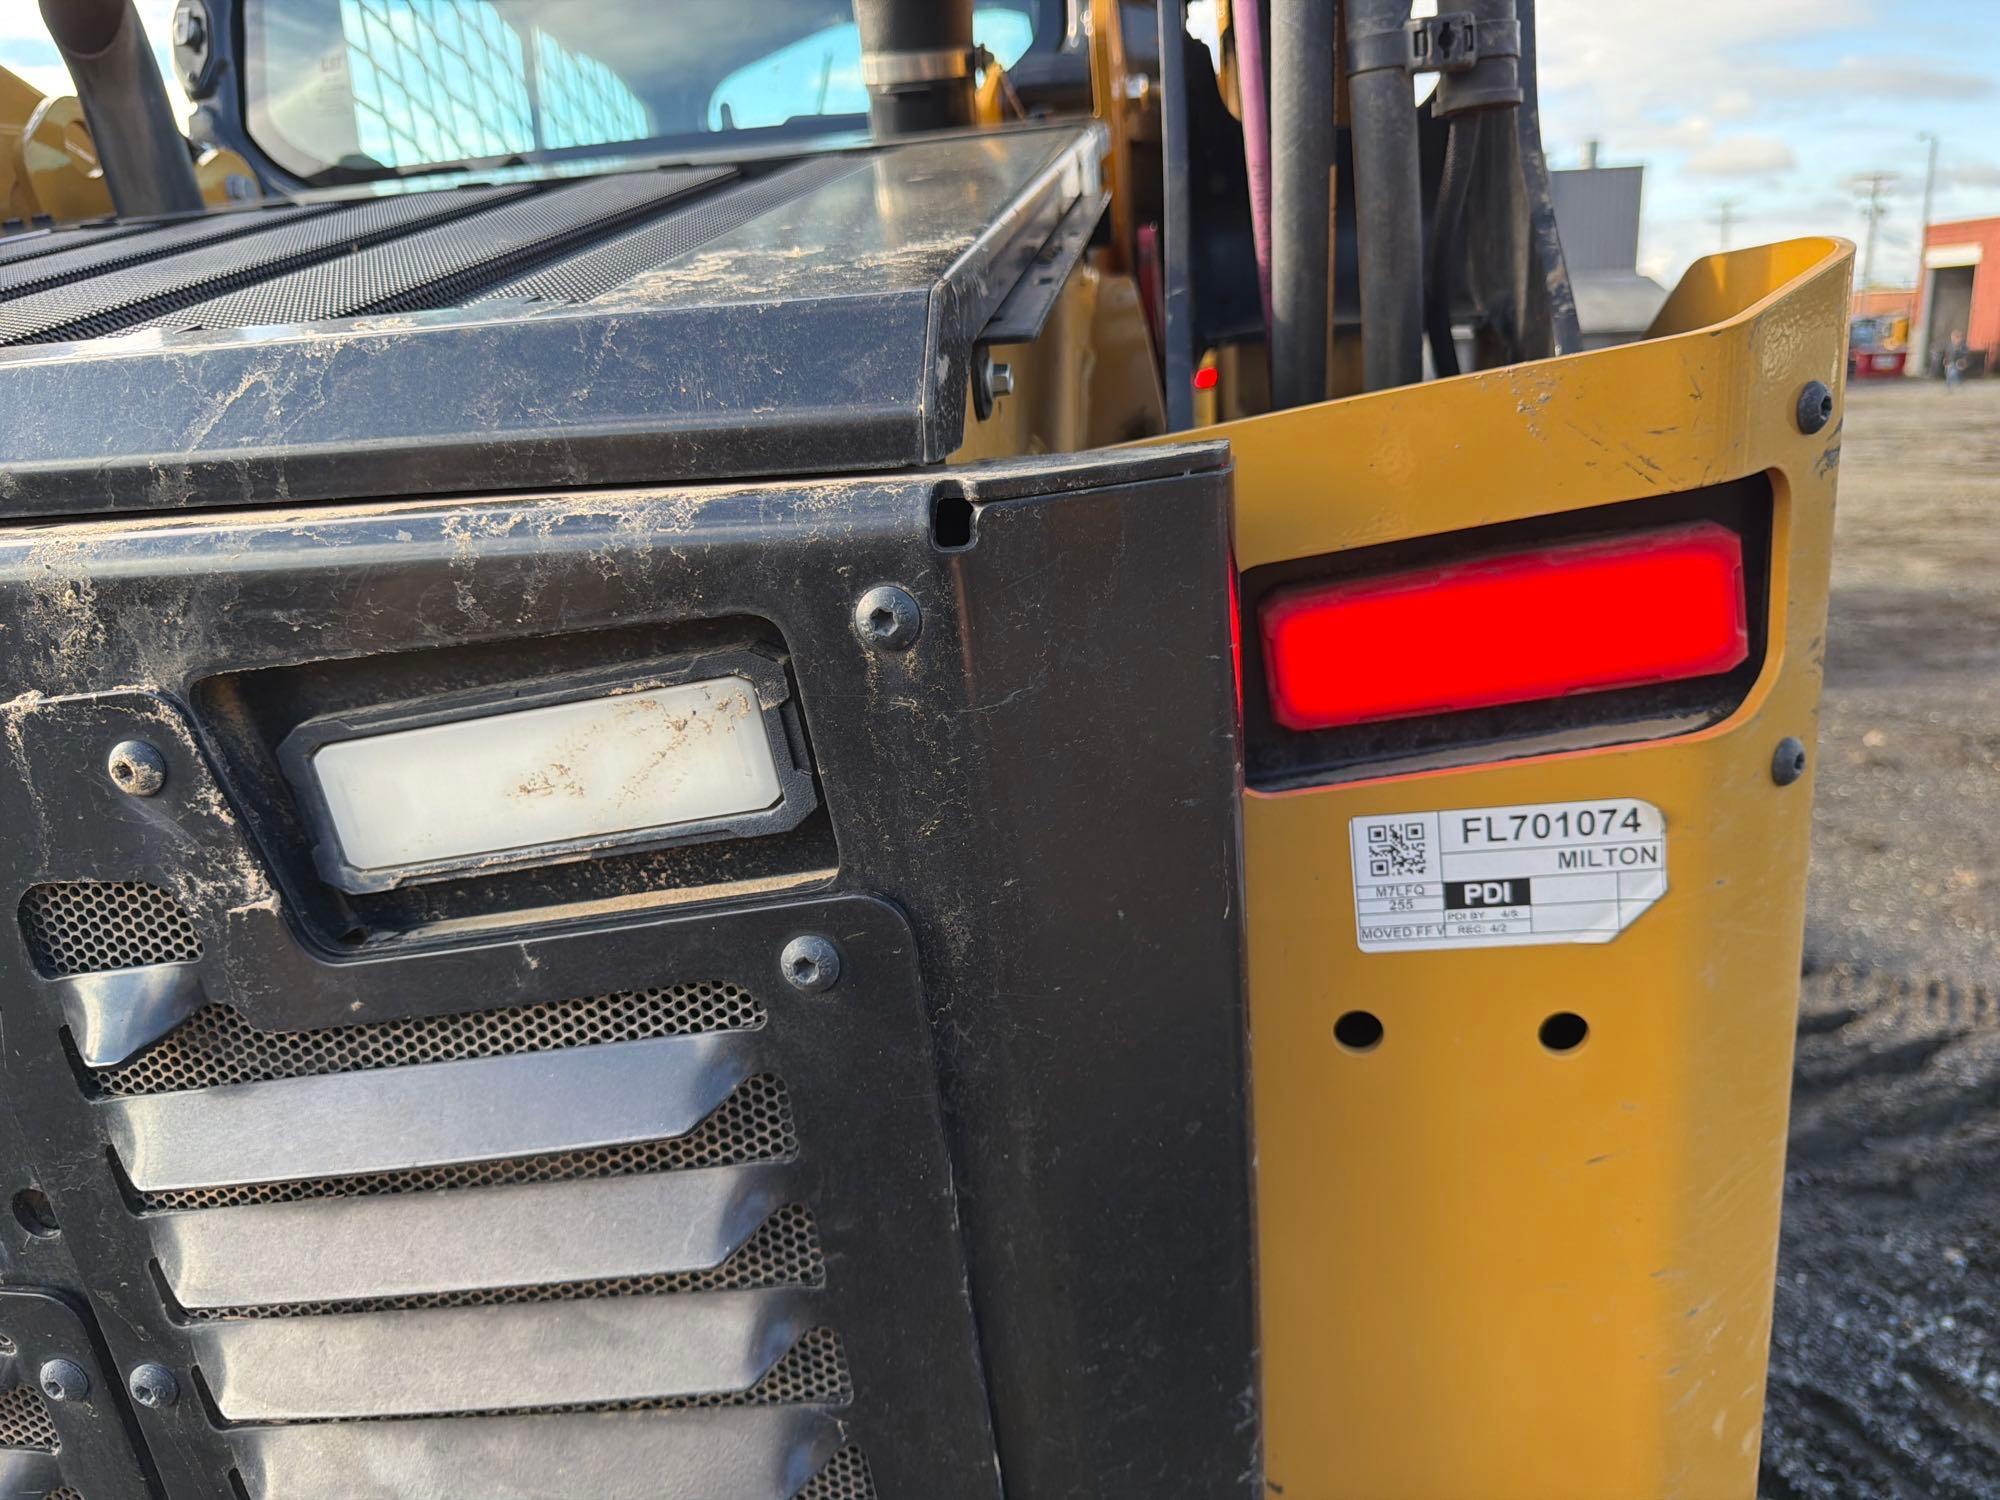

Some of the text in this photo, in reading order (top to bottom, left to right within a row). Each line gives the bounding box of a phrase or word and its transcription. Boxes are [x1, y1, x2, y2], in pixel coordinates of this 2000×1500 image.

[1461, 808, 1642, 844] FL701074
[1557, 845, 1658, 870] MILTON
[1463, 881, 1512, 906] PDI
[1361, 925, 1412, 939] MOVED
